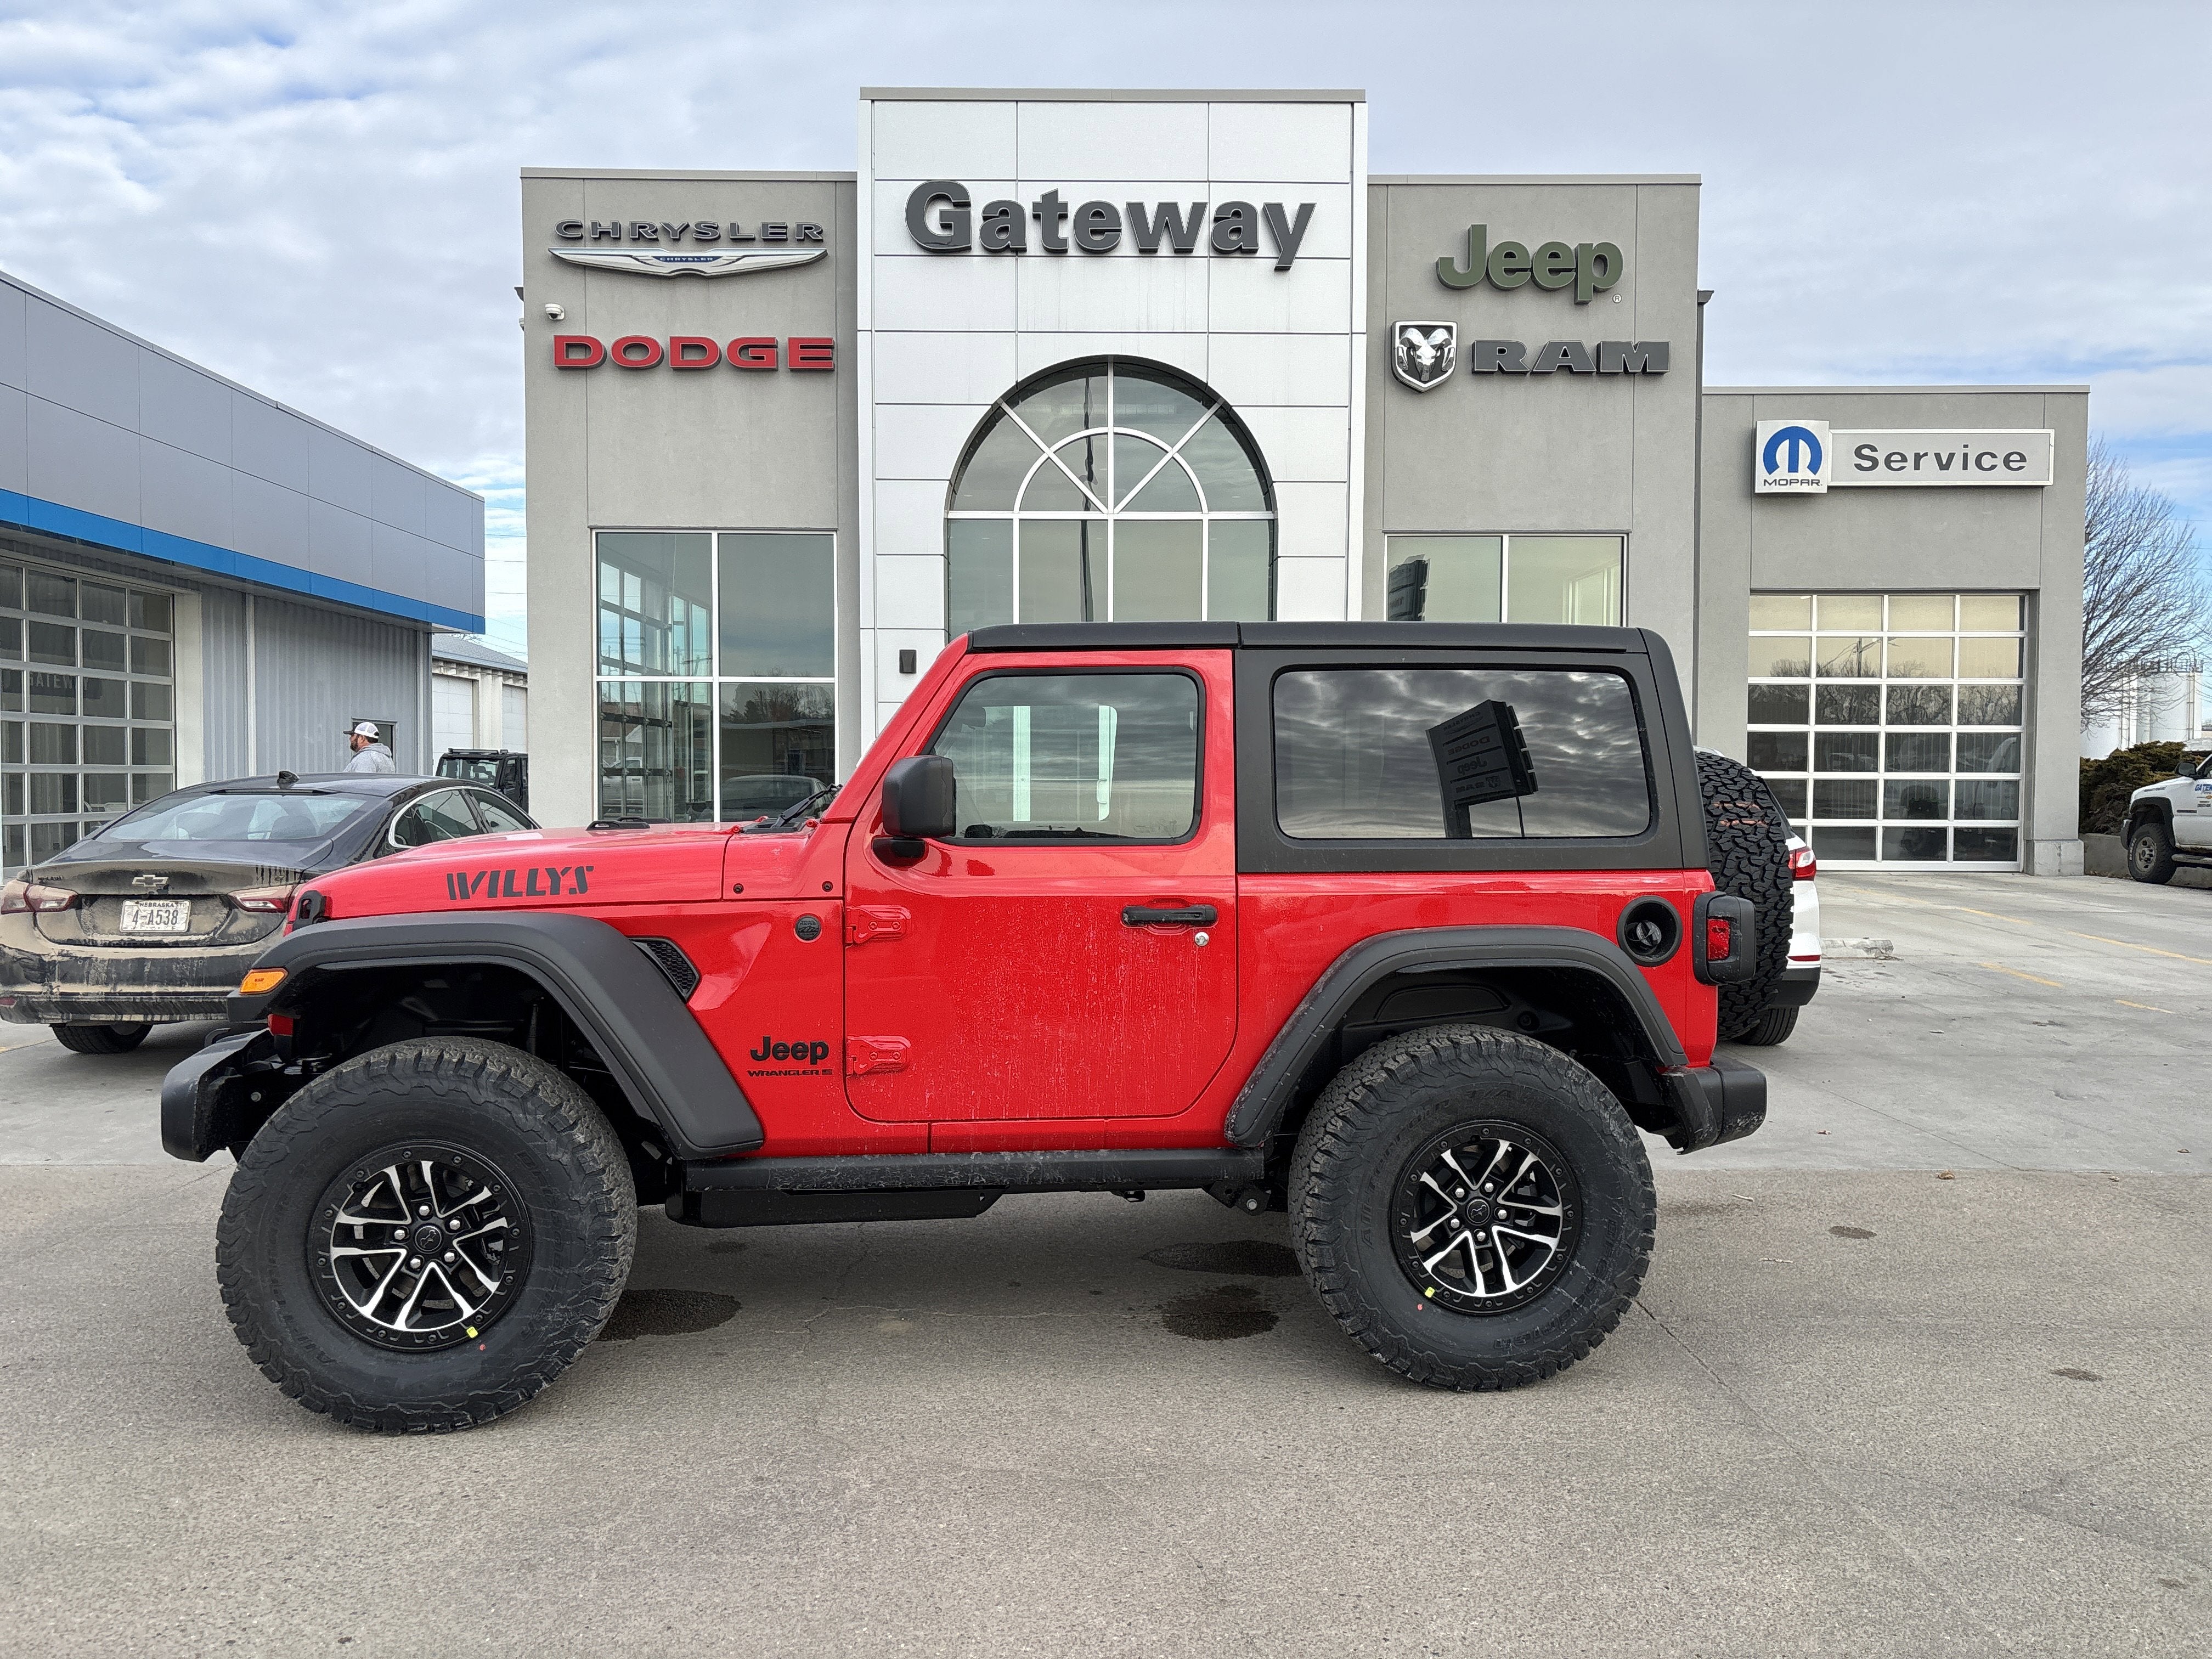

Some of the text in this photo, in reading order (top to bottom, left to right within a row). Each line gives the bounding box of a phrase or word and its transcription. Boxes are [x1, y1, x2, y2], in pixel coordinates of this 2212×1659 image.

[554, 219, 825, 242] CHRYSLER
[905, 180, 1317, 270] Gateway
[1436, 224, 1623, 304] Jeep
[553, 335, 836, 371] DODGE
[1471, 339, 1671, 375] RAM
[1853, 443, 2028, 472] Service
[1763, 478, 1821, 487] MOPAR
[446, 865, 594, 900] WILLYS
[132, 909, 179, 926] 4-A538
[750, 1035, 829, 1065] Jeep
